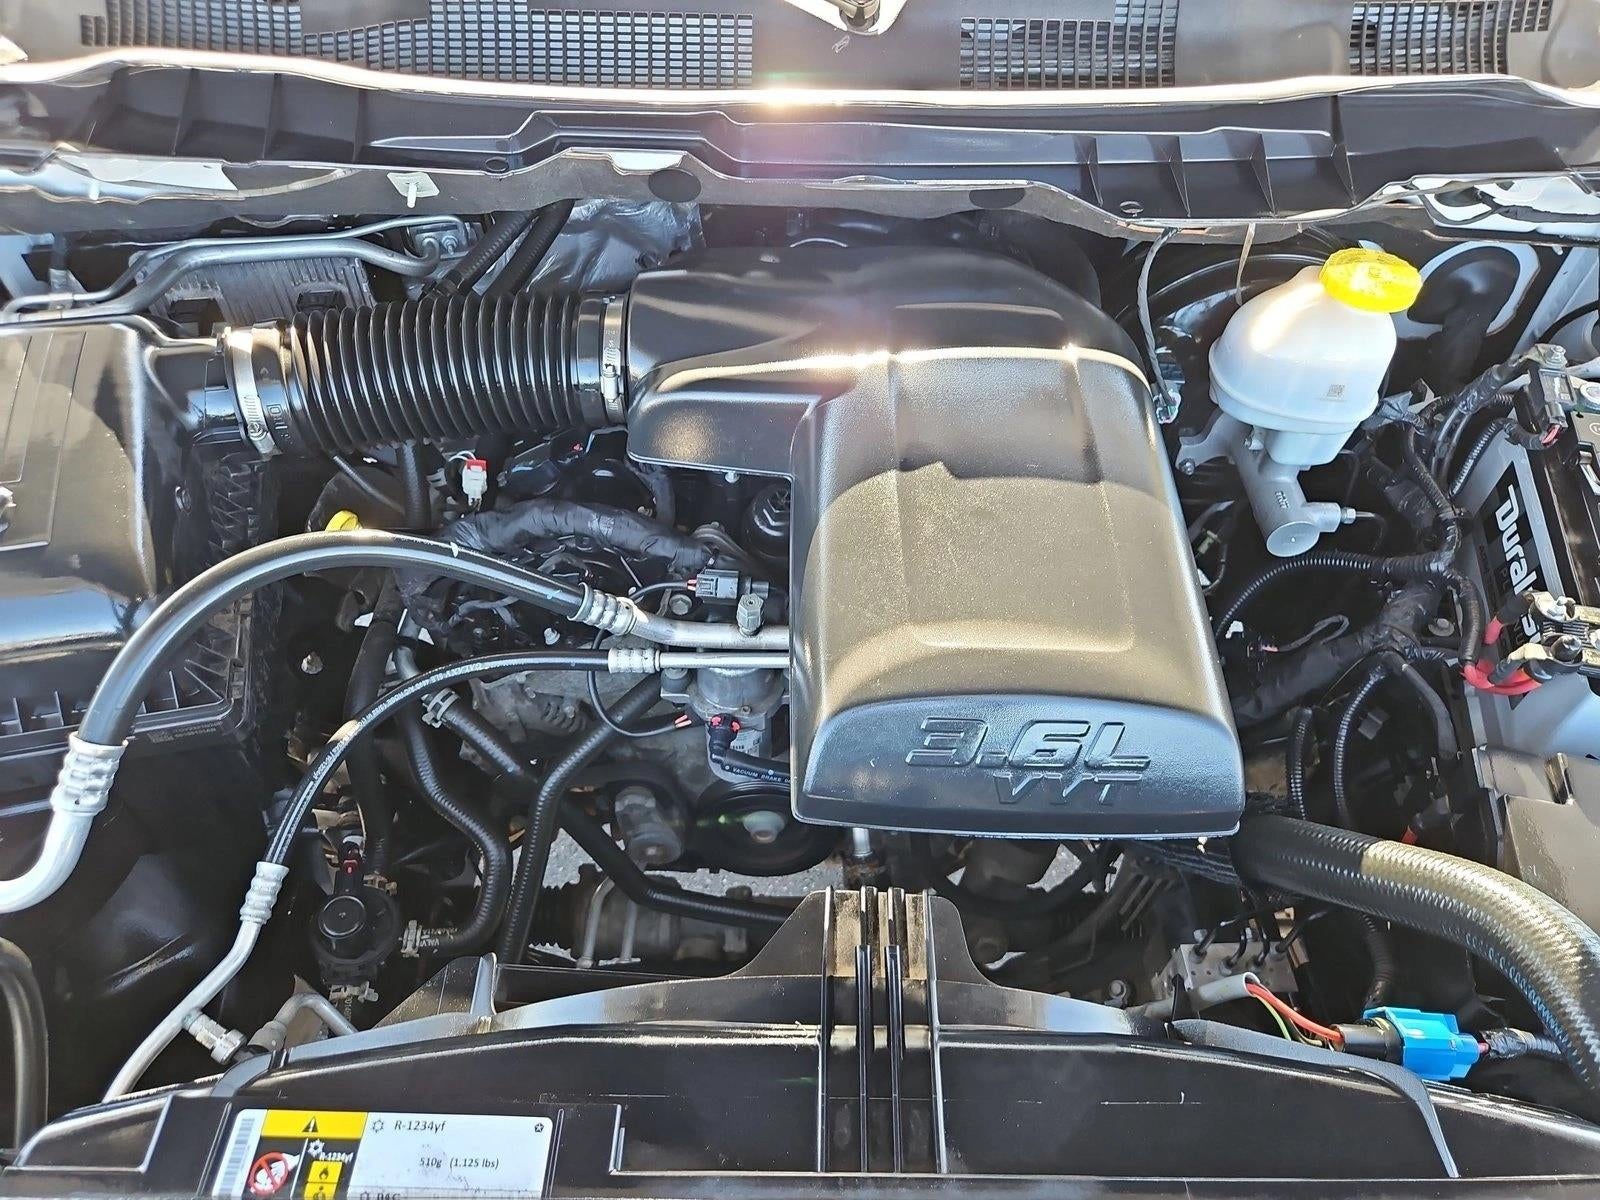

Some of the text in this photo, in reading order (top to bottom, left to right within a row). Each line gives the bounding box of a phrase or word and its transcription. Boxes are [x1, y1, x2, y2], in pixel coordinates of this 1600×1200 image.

[905, 716, 1152, 769] 3.6L
[732, 766, 759, 779] VACUUM
[993, 772, 1144, 806] VVT
[394, 1120, 447, 1134] R-1234yf
[420, 1157, 499, 1170] 510g (1.125 lbs)
